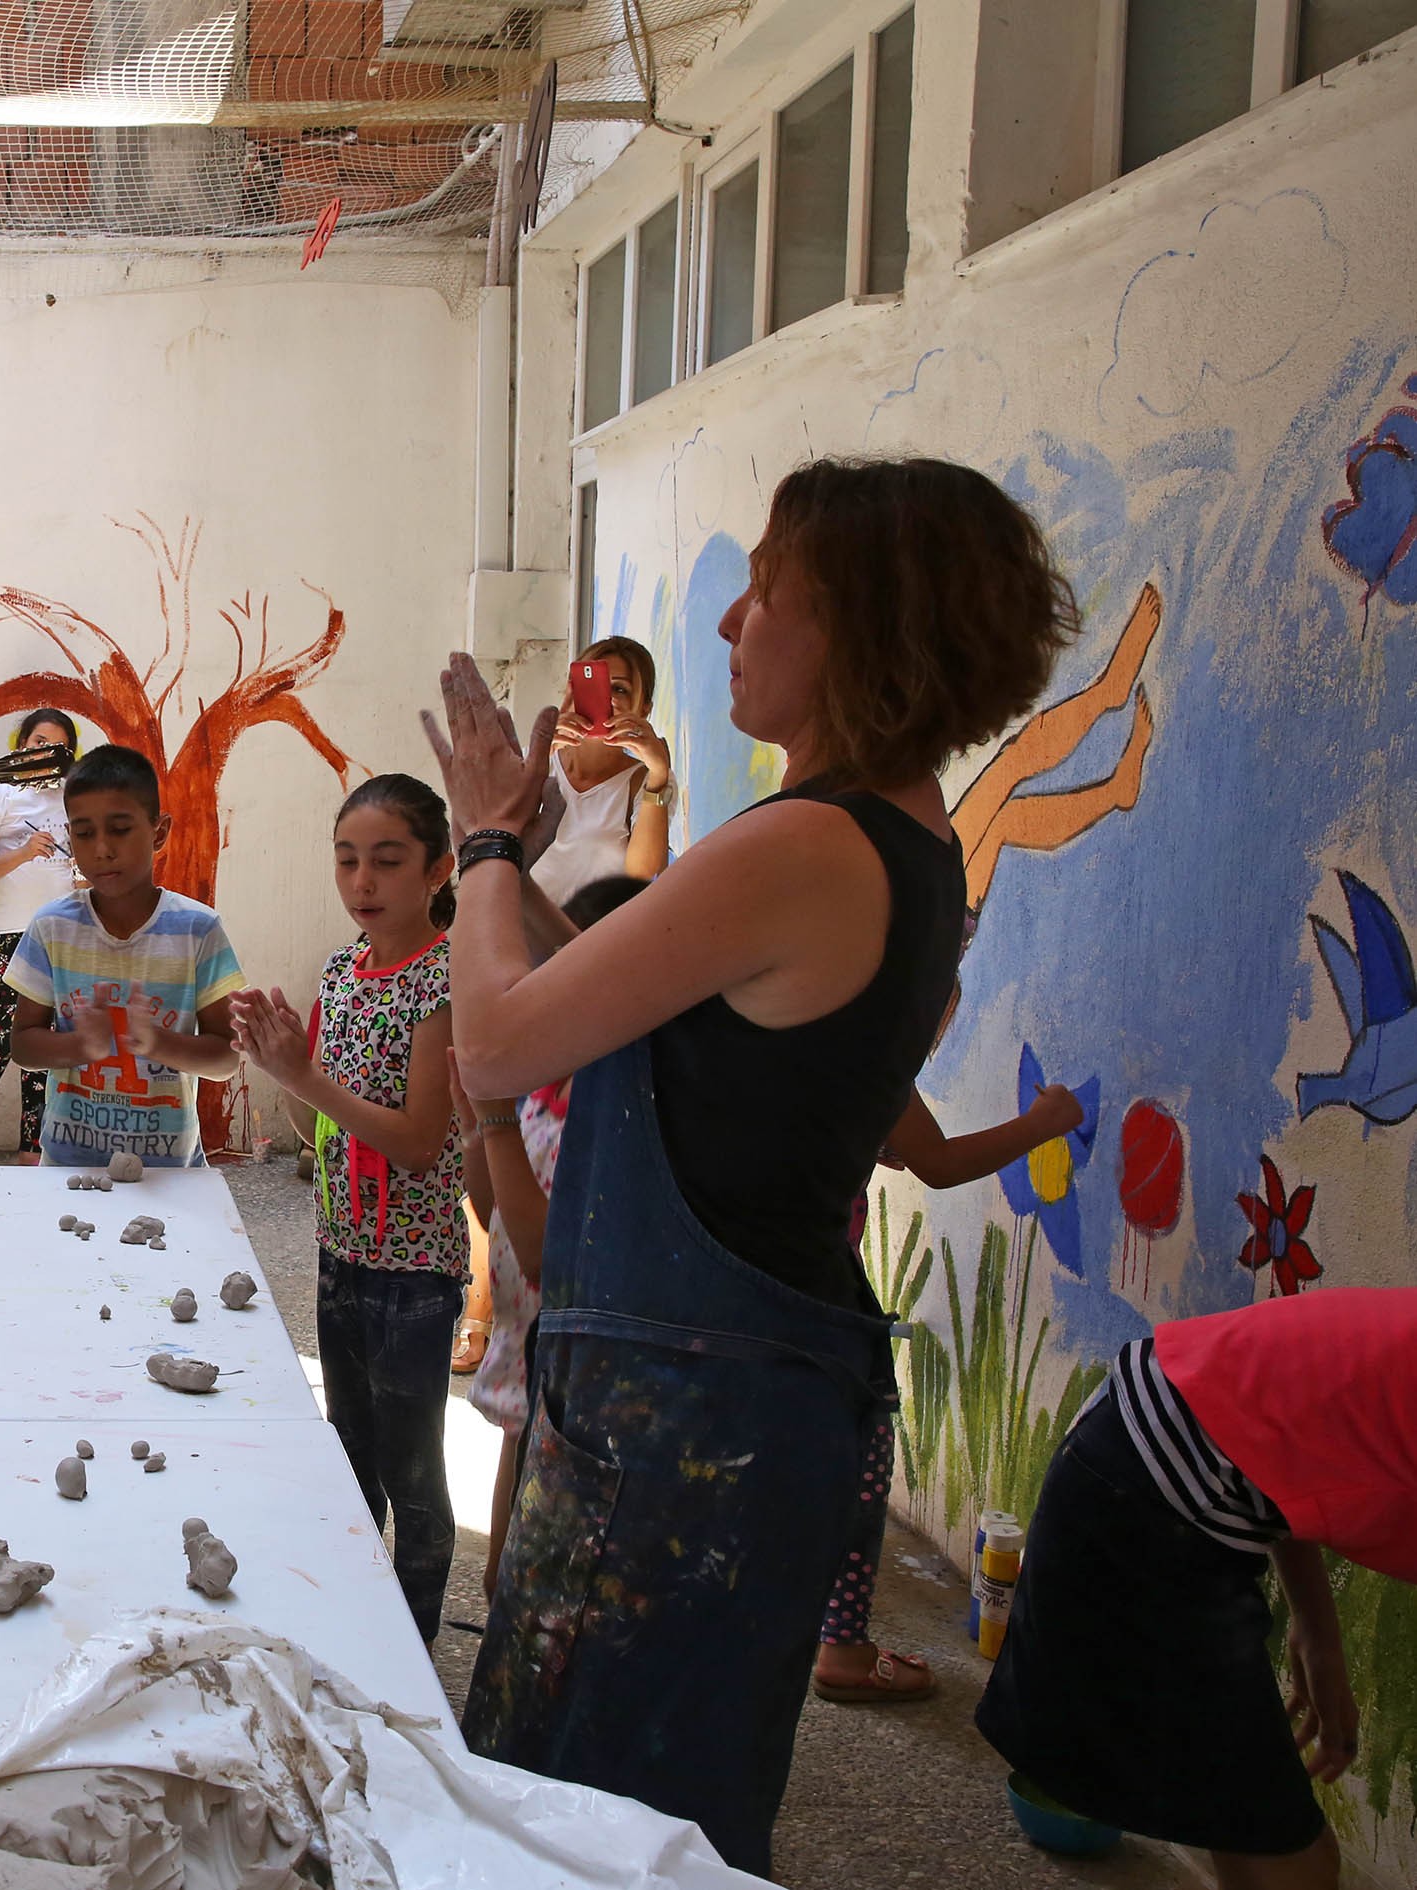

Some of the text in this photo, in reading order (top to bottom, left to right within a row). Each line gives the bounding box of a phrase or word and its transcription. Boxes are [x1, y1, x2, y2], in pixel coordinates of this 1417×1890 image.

[69, 1098, 161, 1134] SPORTS
[91, 1091, 132, 1108] STRENGTH
[50, 1121, 178, 1157] INDUSTRY
